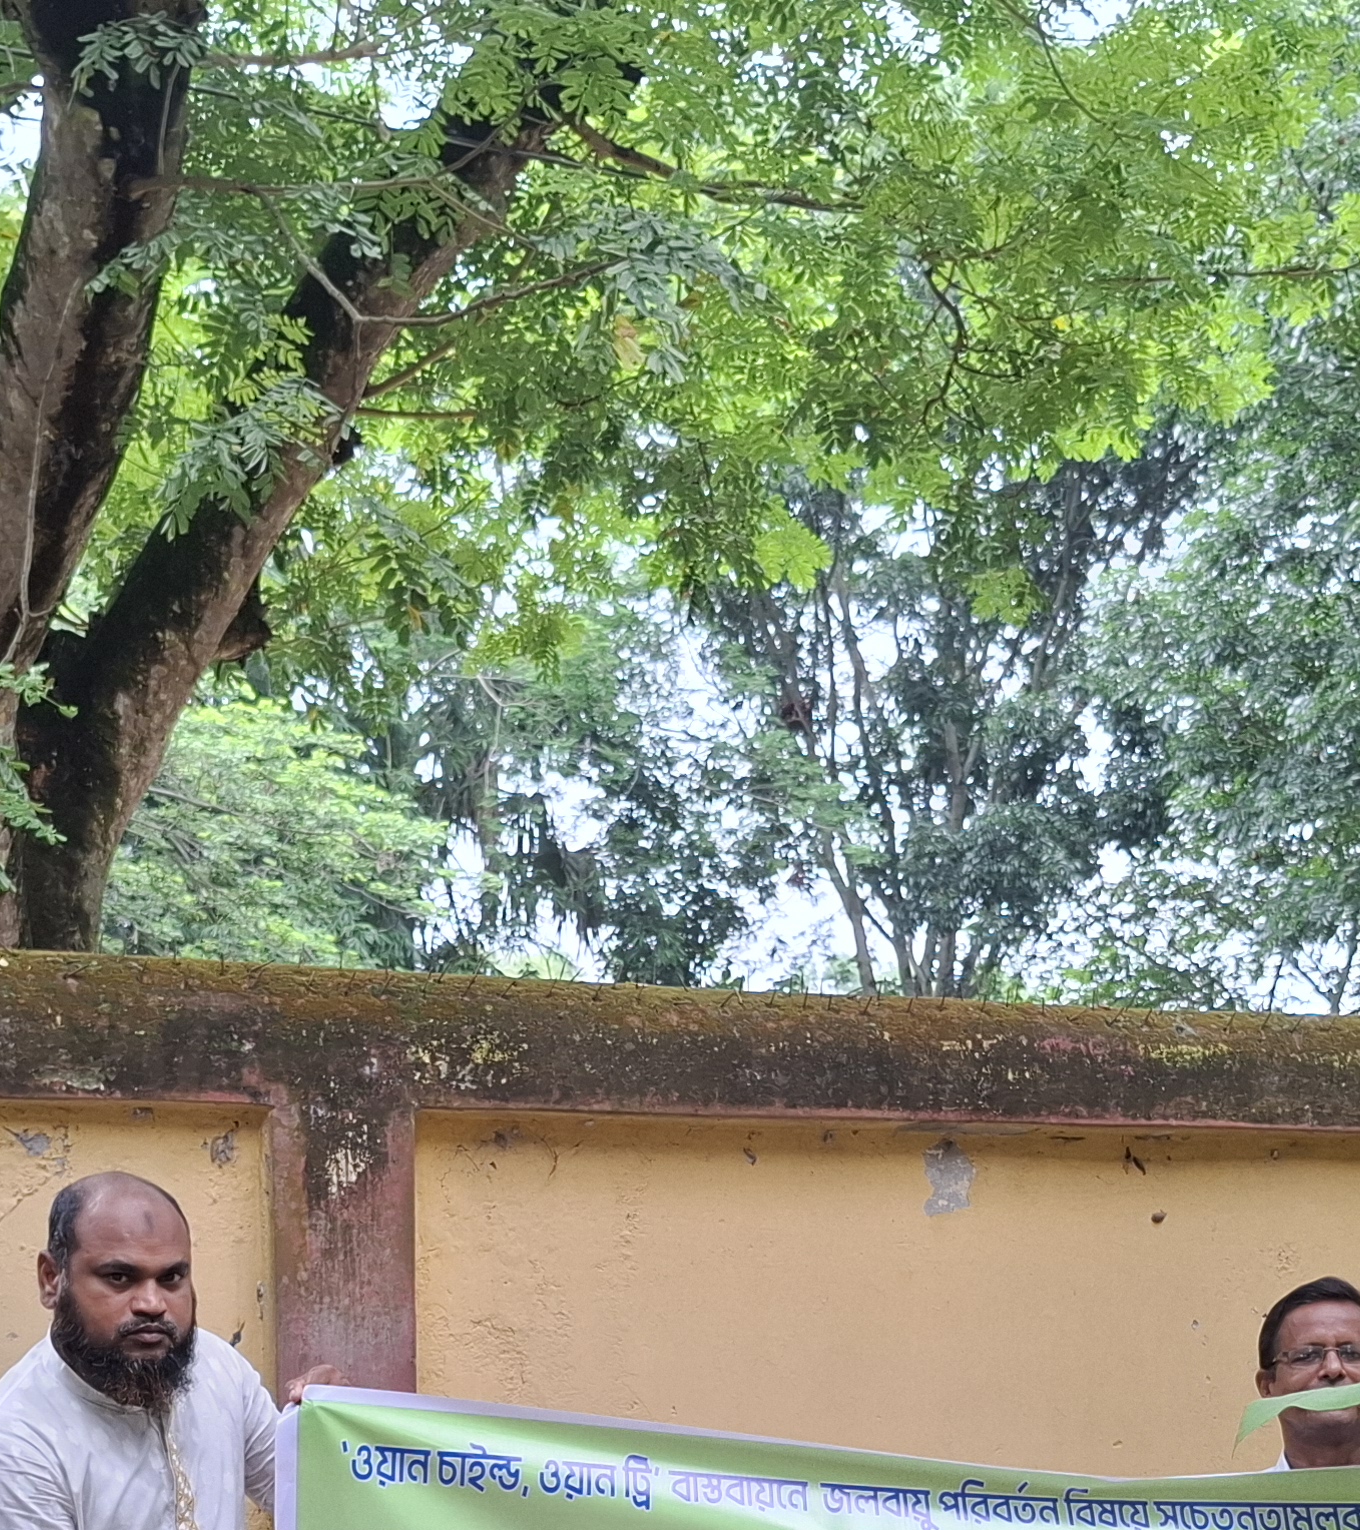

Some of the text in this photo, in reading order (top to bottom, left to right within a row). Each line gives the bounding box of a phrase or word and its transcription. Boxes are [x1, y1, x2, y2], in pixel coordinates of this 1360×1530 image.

[437, 1443, 529, 1497] চাইল্ড,
[540, 1459, 616, 1500] ওয়ান
[669, 1469, 809, 1513] বাস্তবায়নে
[819, 1482, 939, 1530] জলবায়ু
[939, 1479, 1061, 1526] পরিবর্তন
[1064, 1488, 1151, 1530] বিষয়ে
